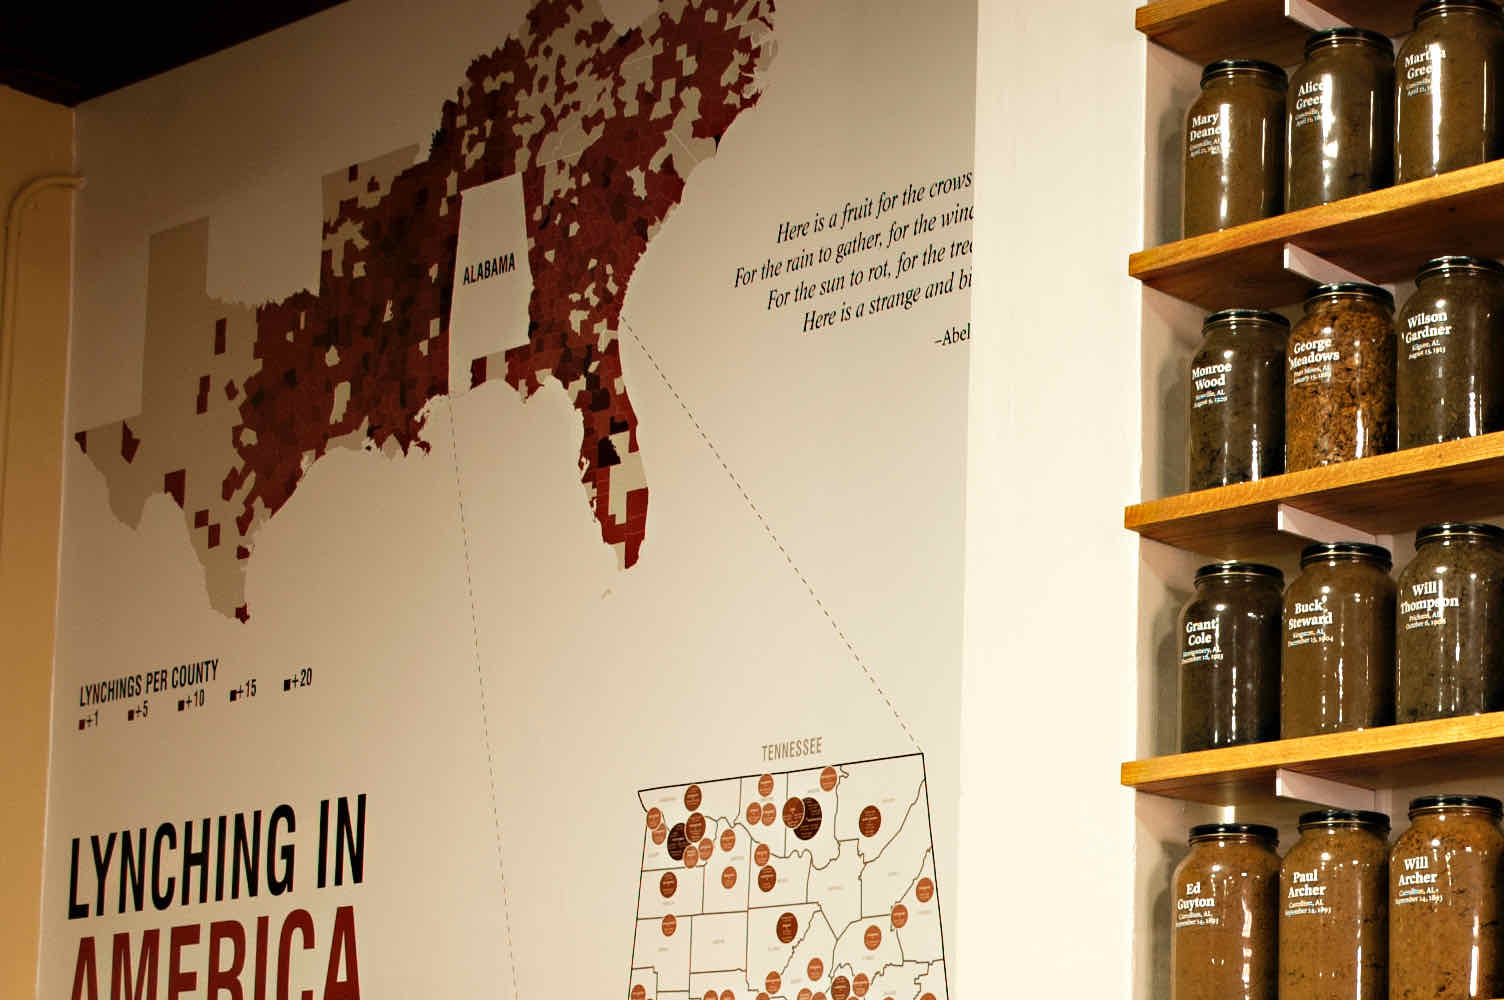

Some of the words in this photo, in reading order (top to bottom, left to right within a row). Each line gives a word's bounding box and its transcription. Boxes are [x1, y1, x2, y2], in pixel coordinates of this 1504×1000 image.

[776, 220, 810, 243] Here
[814, 213, 825, 233] is
[840, 198, 872, 230] fruit
[876, 192, 899, 219] for
[902, 184, 926, 207] the
[734, 266, 757, 288] For
[761, 258, 782, 280] the
[786, 249, 813, 273] rain
[818, 244, 832, 262] to
[836, 231, 882, 263] gather,
[886, 221, 910, 248] for
[913, 213, 937, 236] the
[463, 252, 515, 286] ALABAMA
[767, 288, 790, 310] For
[794, 281, 816, 302] the
[819, 275, 845, 296] sun
[849, 269, 864, 287] to
[868, 259, 891, 280] rot,
[895, 251, 918, 279] for
[922, 243, 946, 267] the
[802, 311, 836, 332] Here
[840, 302, 851, 322] is
[868, 286, 921, 314] strange
[925, 271, 955, 298] and
[1407, 312, 1448, 328] Wilson
[1405, 324, 1452, 344] Gardner
[1293, 337, 1332, 355] George
[1289, 350, 1340, 369] Meadows
[1192, 362, 1232, 379] Monroe
[1195, 375, 1226, 391] Wood
[1295, 600, 1323, 614] Buck
[1186, 620, 1216, 634] Grant
[1288, 611, 1333, 628] Steward
[1188, 631, 1212, 646] Cole
[80, 675, 141, 707] LYNCHINGS
[146, 671, 167, 695] PER
[172, 659, 219, 688] COUNTY
[761, 736, 823, 761] TENNESSEE
[68, 804, 296, 919] LYNCHING
[317, 794, 367, 889] IN
[1404, 857, 1428, 871] Will
[1293, 870, 1318, 884] Paul
[1398, 870, 1438, 886] Archer
[1288, 884, 1326, 899] Archer
